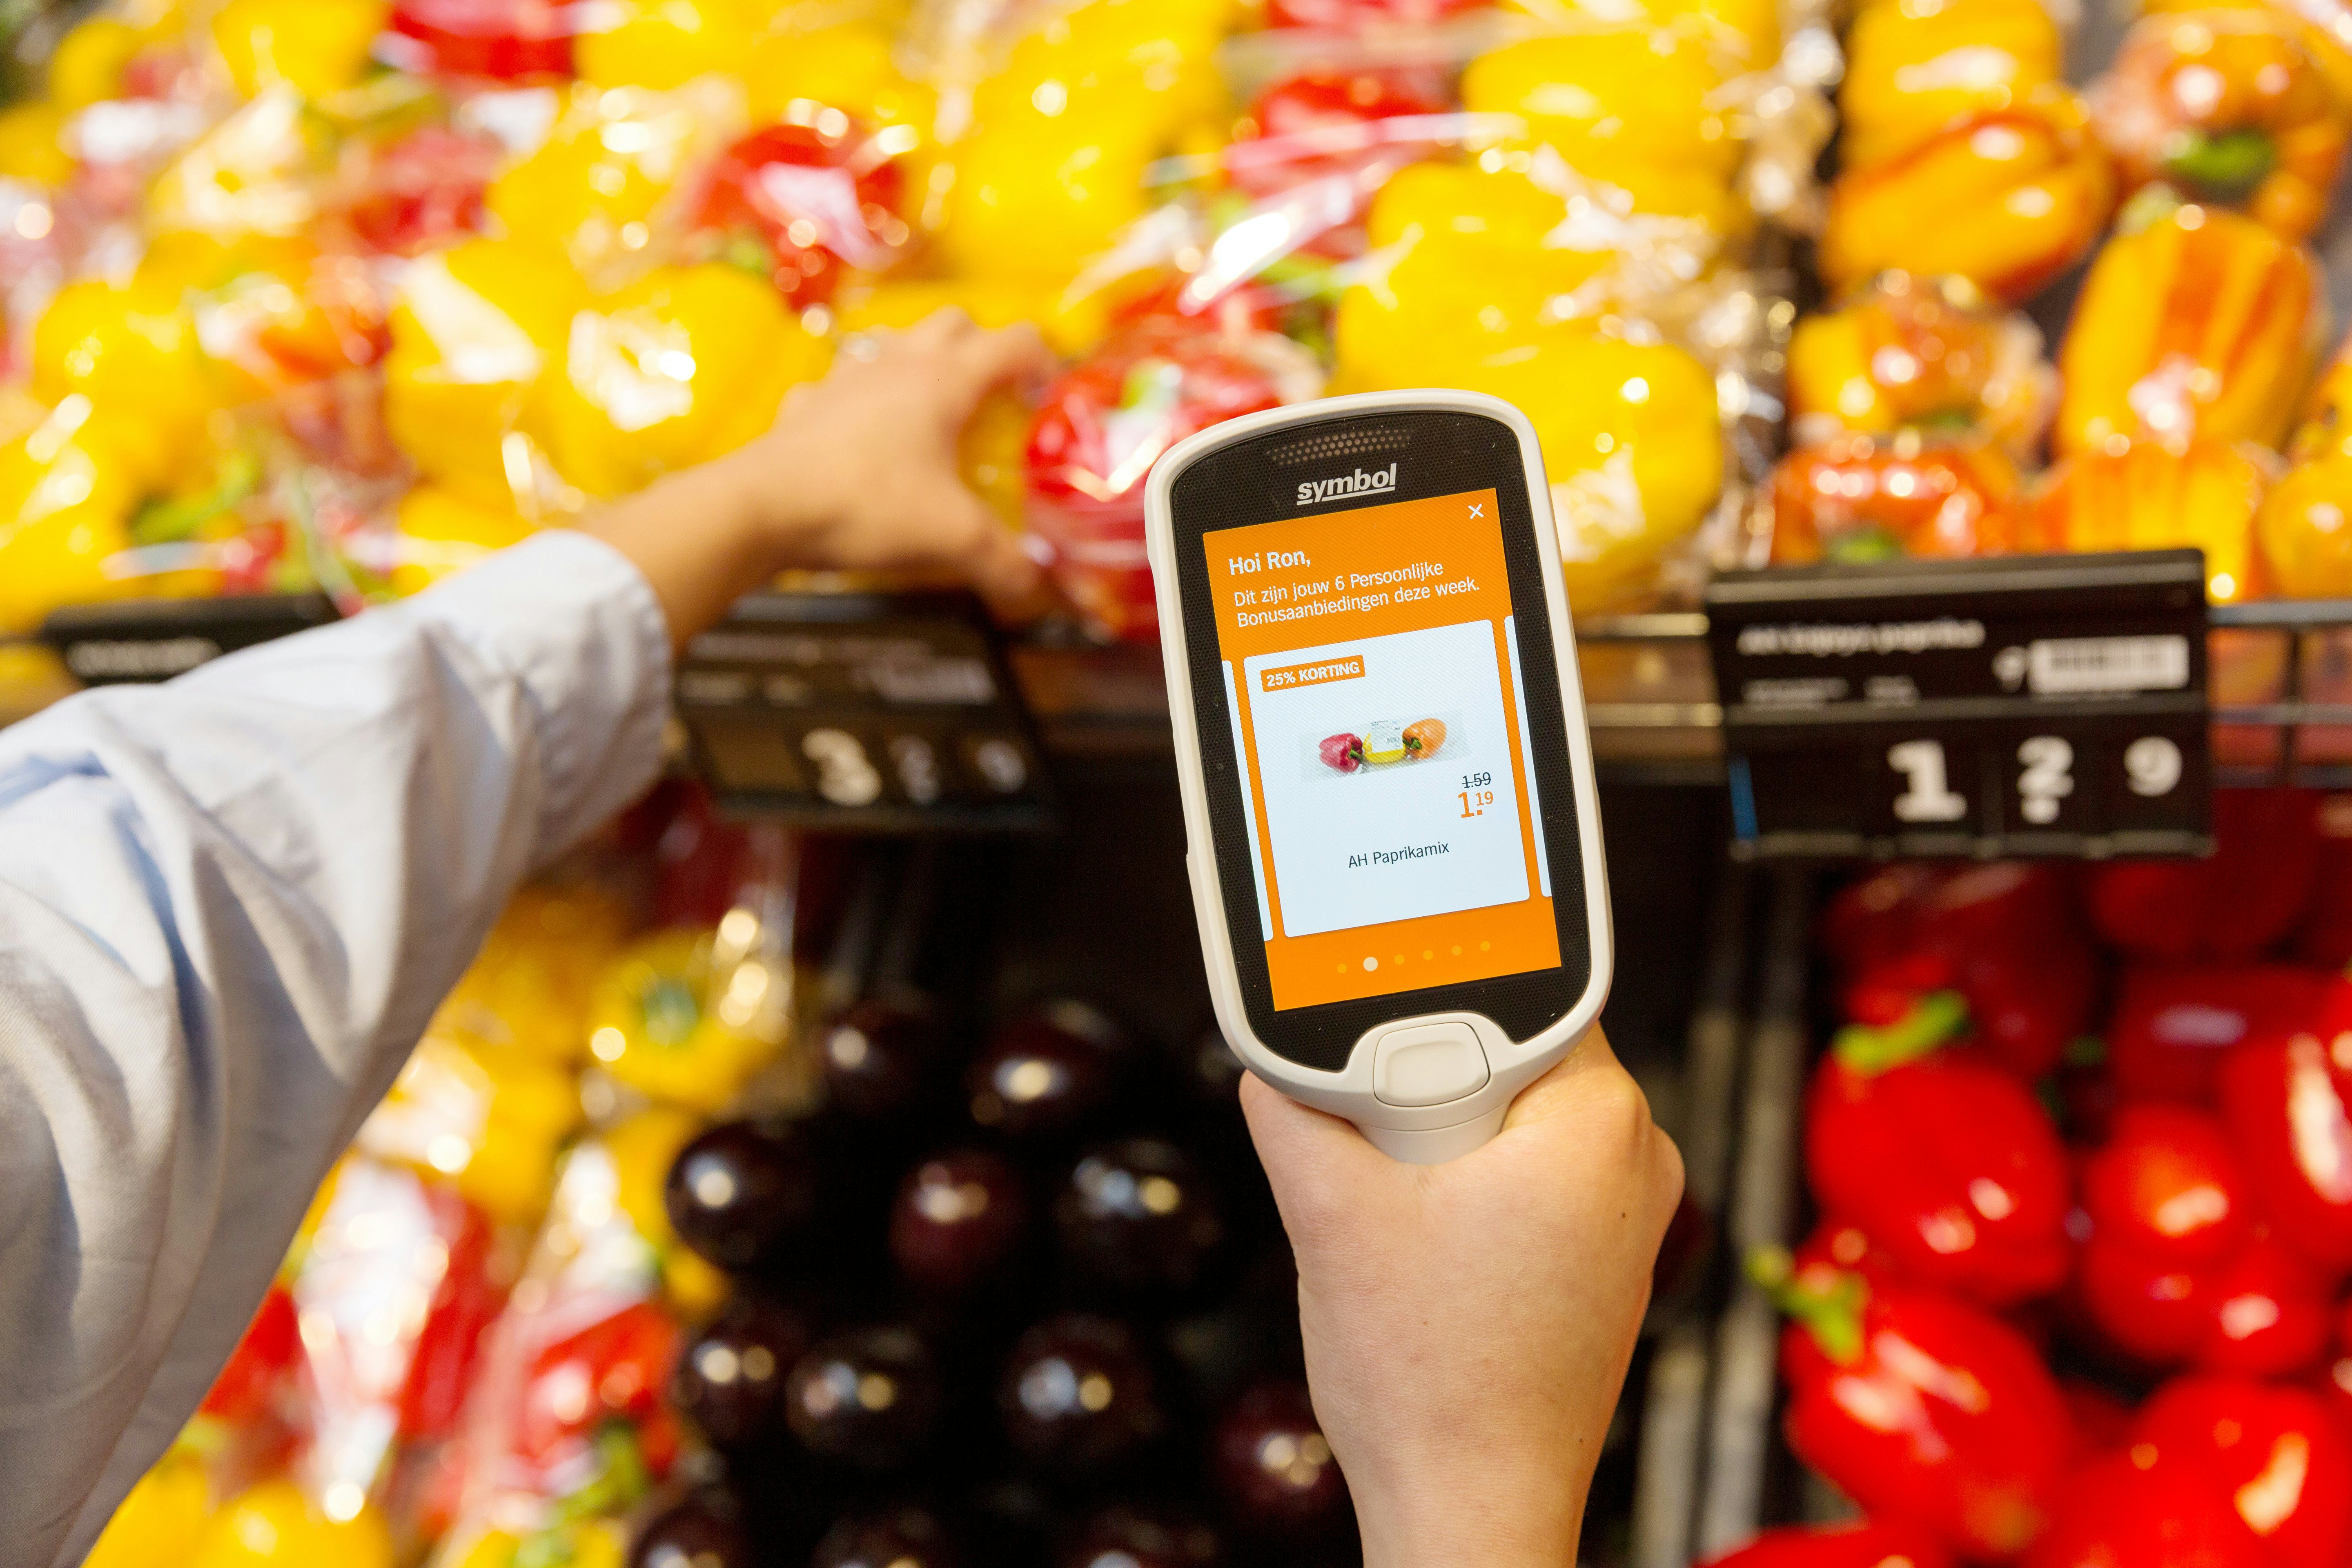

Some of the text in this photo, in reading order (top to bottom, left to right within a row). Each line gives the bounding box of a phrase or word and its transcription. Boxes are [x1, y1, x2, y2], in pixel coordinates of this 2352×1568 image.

[1296, 463, 1396, 506] symbol
[1229, 551, 1311, 576] Hoi Ron,
[1234, 561, 1443, 607] Dit zijn jouw 6 Persoonlijke
[1237, 576, 1480, 628] Bonusaanbiedingen deze week.
[1266, 661, 1360, 687] 25% KORTING
[1461, 771, 1492, 788] 1.59
[1348, 841, 1450, 868] AH Paprikamix
